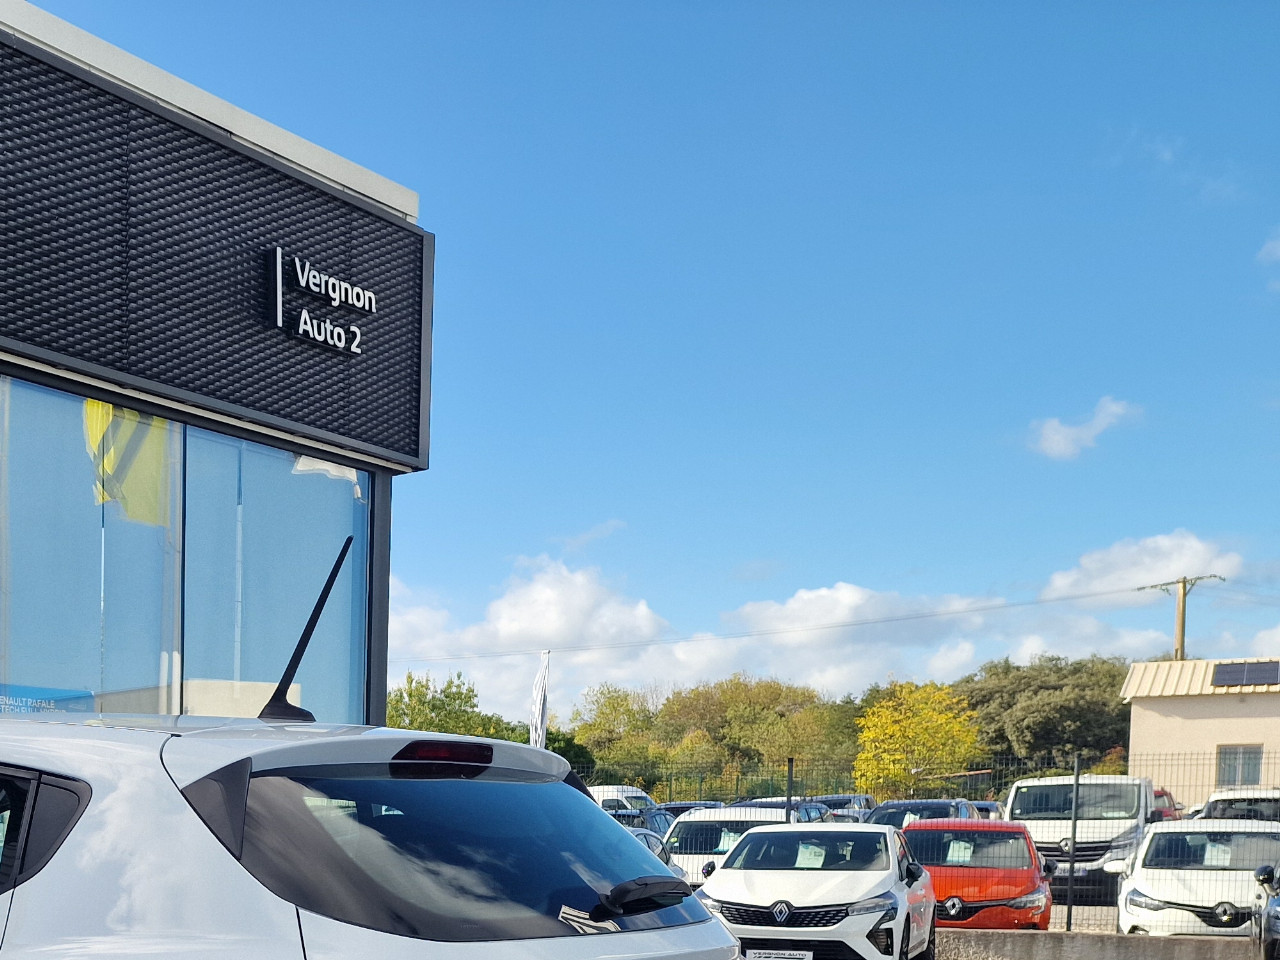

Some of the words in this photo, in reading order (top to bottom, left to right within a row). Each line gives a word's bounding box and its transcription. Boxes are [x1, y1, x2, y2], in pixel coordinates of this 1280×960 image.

[295, 257, 376, 313] Vergnon
[299, 309, 346, 348] Auto
[350, 325, 361, 354] 2
[28, 699, 55, 708] RAFALE
